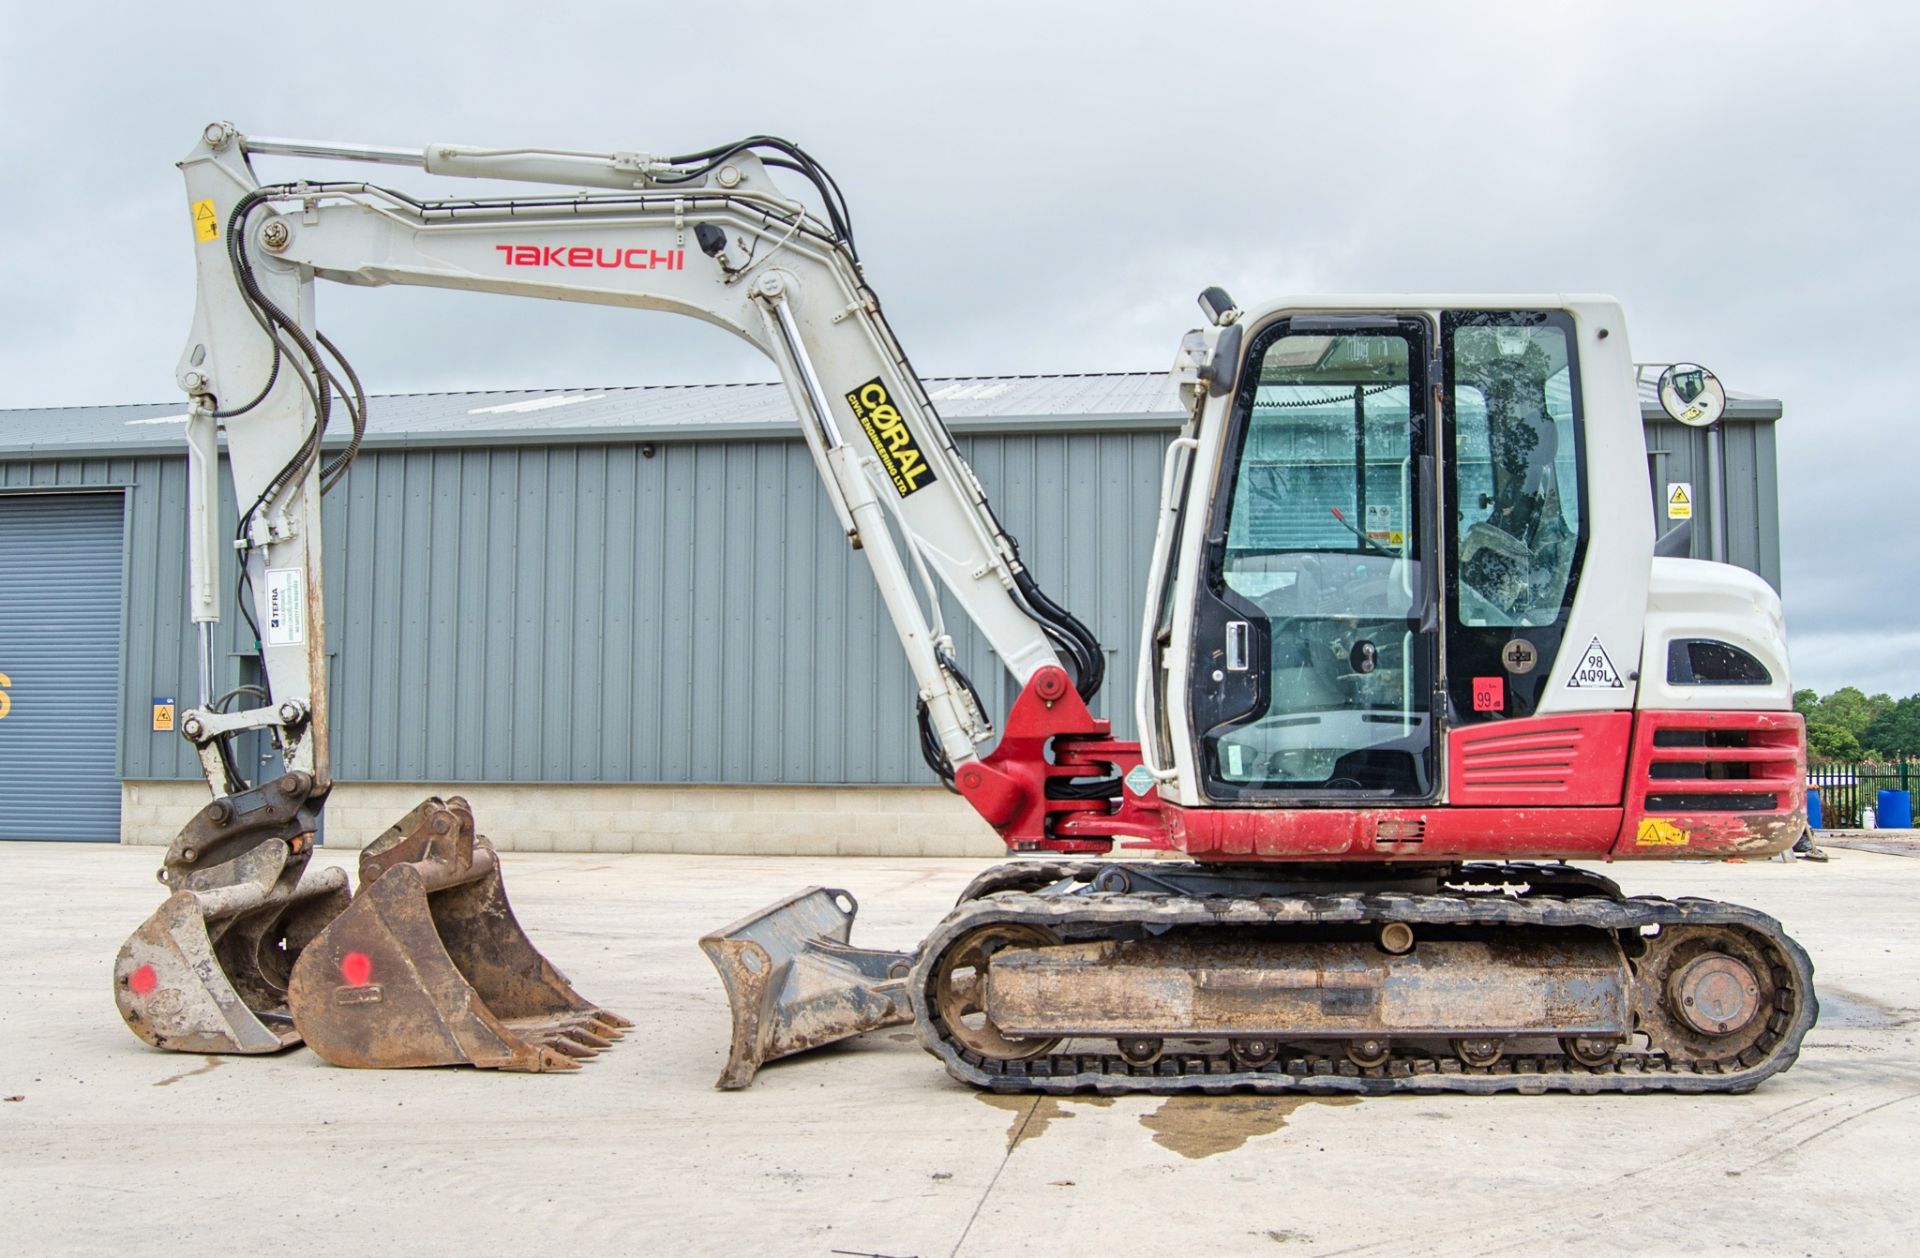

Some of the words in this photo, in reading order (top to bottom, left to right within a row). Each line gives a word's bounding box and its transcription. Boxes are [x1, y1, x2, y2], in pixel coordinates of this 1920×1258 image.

[496, 245, 684, 270] TAKEUCHI
[848, 394, 863, 418] CIVIL
[861, 417, 897, 475] ENGINEERING
[894, 473, 908, 496] LTD.
[1588, 656, 1603, 669] 98
[1580, 670, 1612, 682] AQ9L
[1477, 692, 1491, 708] 99
